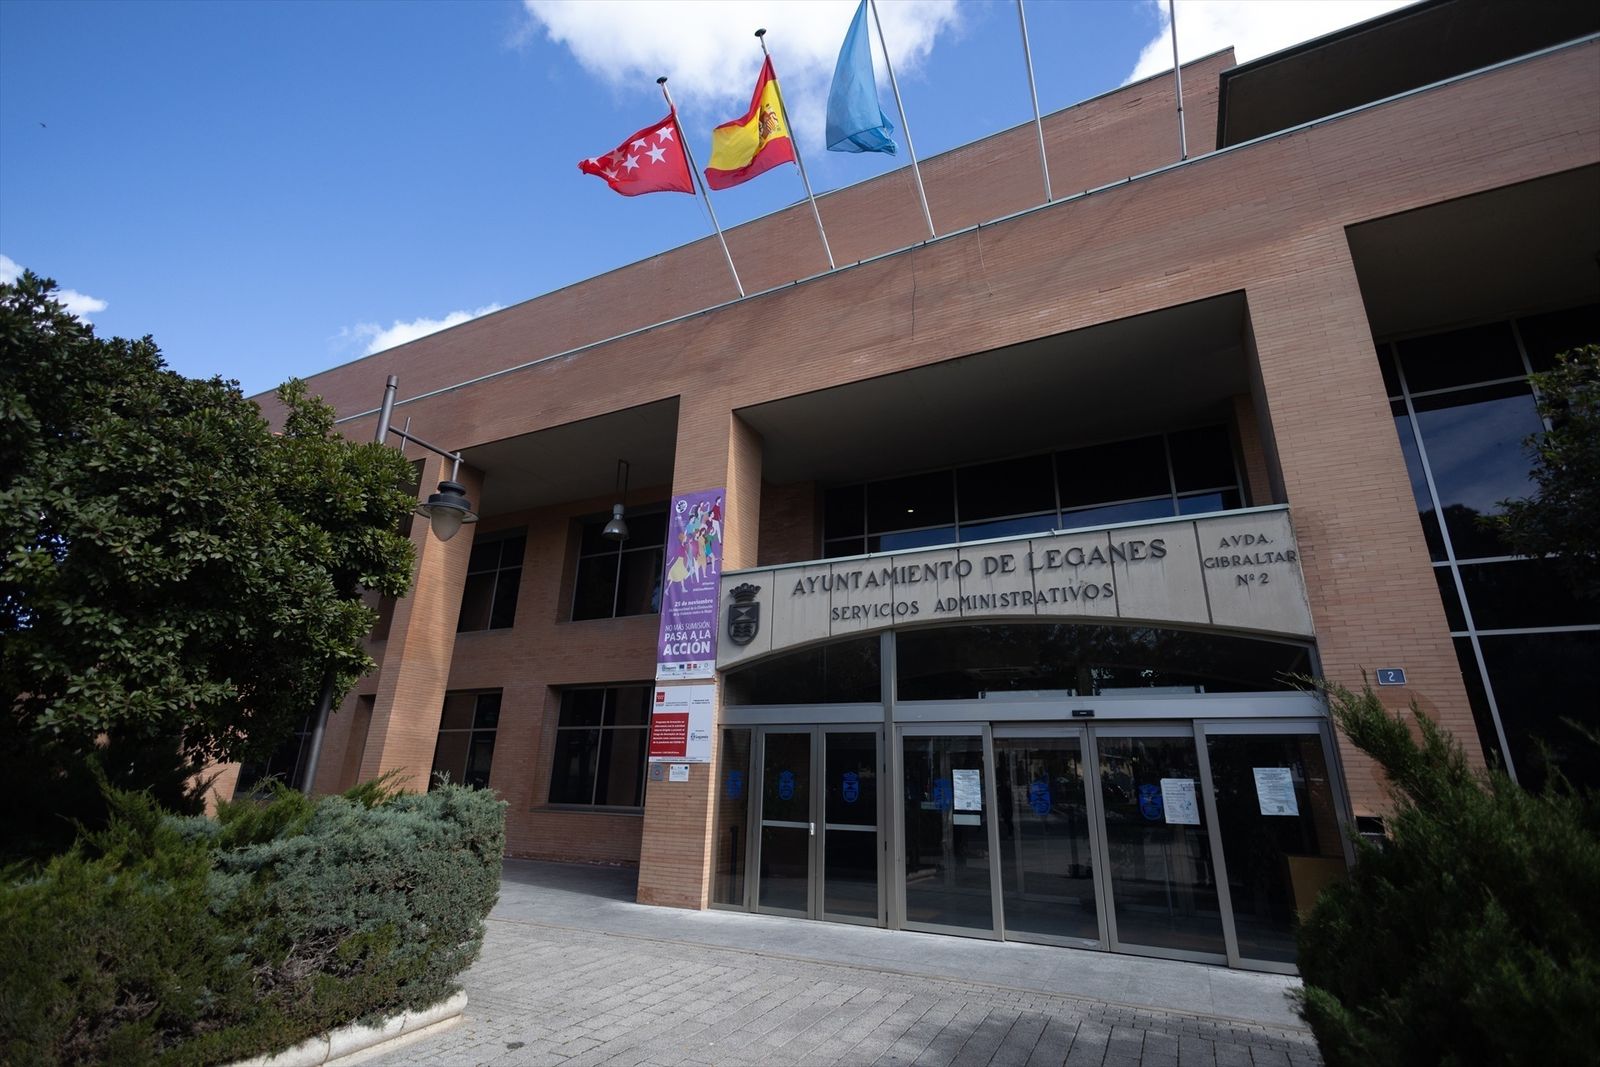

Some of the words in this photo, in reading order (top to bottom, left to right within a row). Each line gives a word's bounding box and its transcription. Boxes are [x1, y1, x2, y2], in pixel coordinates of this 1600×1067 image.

[792, 558, 973, 596] AYUNTAMIENTO
[983, 554, 1016, 576] DE
[1028, 538, 1168, 572] LEGANES
[1203, 550, 1297, 569] GIBRALTAR
[1260, 572, 1269, 584] 2
[832, 600, 920, 621] SERVICIOS
[934, 582, 1114, 613] ADMINISTRATIVOS
[674, 622, 684, 631] MÁS
[664, 632, 688, 642] PASA
[690, 630, 697, 640] A
[700, 630, 711, 639] LA
[663, 638, 710, 656] ACCIÓN
[1388, 671, 1395, 682] 2
